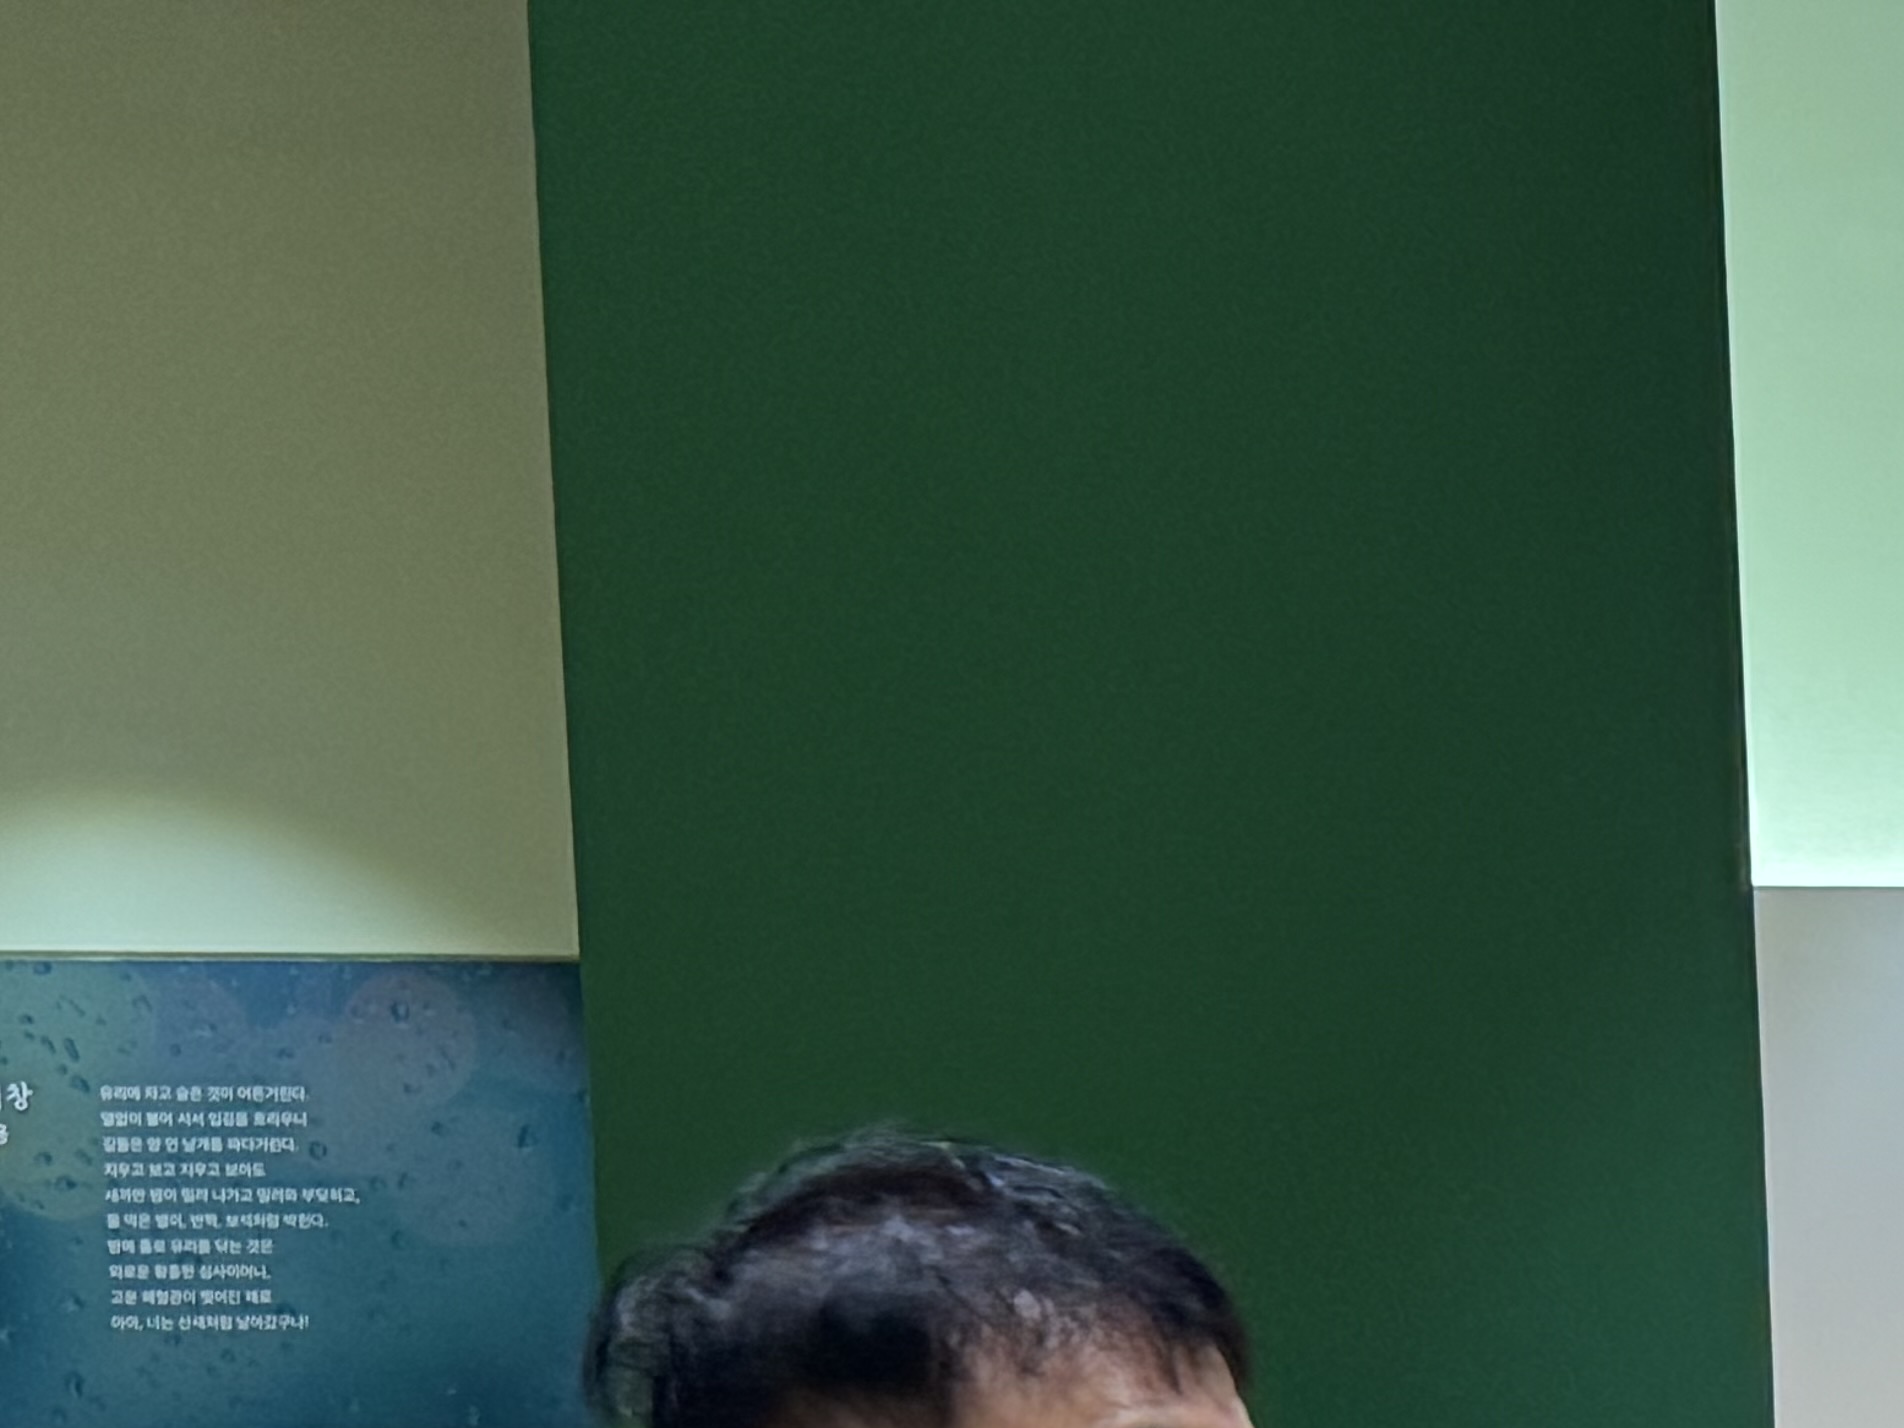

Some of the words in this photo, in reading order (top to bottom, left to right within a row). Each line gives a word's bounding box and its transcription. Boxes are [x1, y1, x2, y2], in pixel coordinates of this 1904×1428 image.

[207, 1085, 234, 1102] 것이
[177, 1111, 205, 1127] 서서
[104, 1162, 145, 1178] 지우고
[148, 1162, 176, 1178] 보고
[180, 1162, 221, 1178] 지우고
[225, 1162, 266, 1178] 보아도
[211, 1187, 253, 1204] 나가고
[246, 1238, 273, 1255] 것은
[110, 1314, 144, 1332] 아아,
